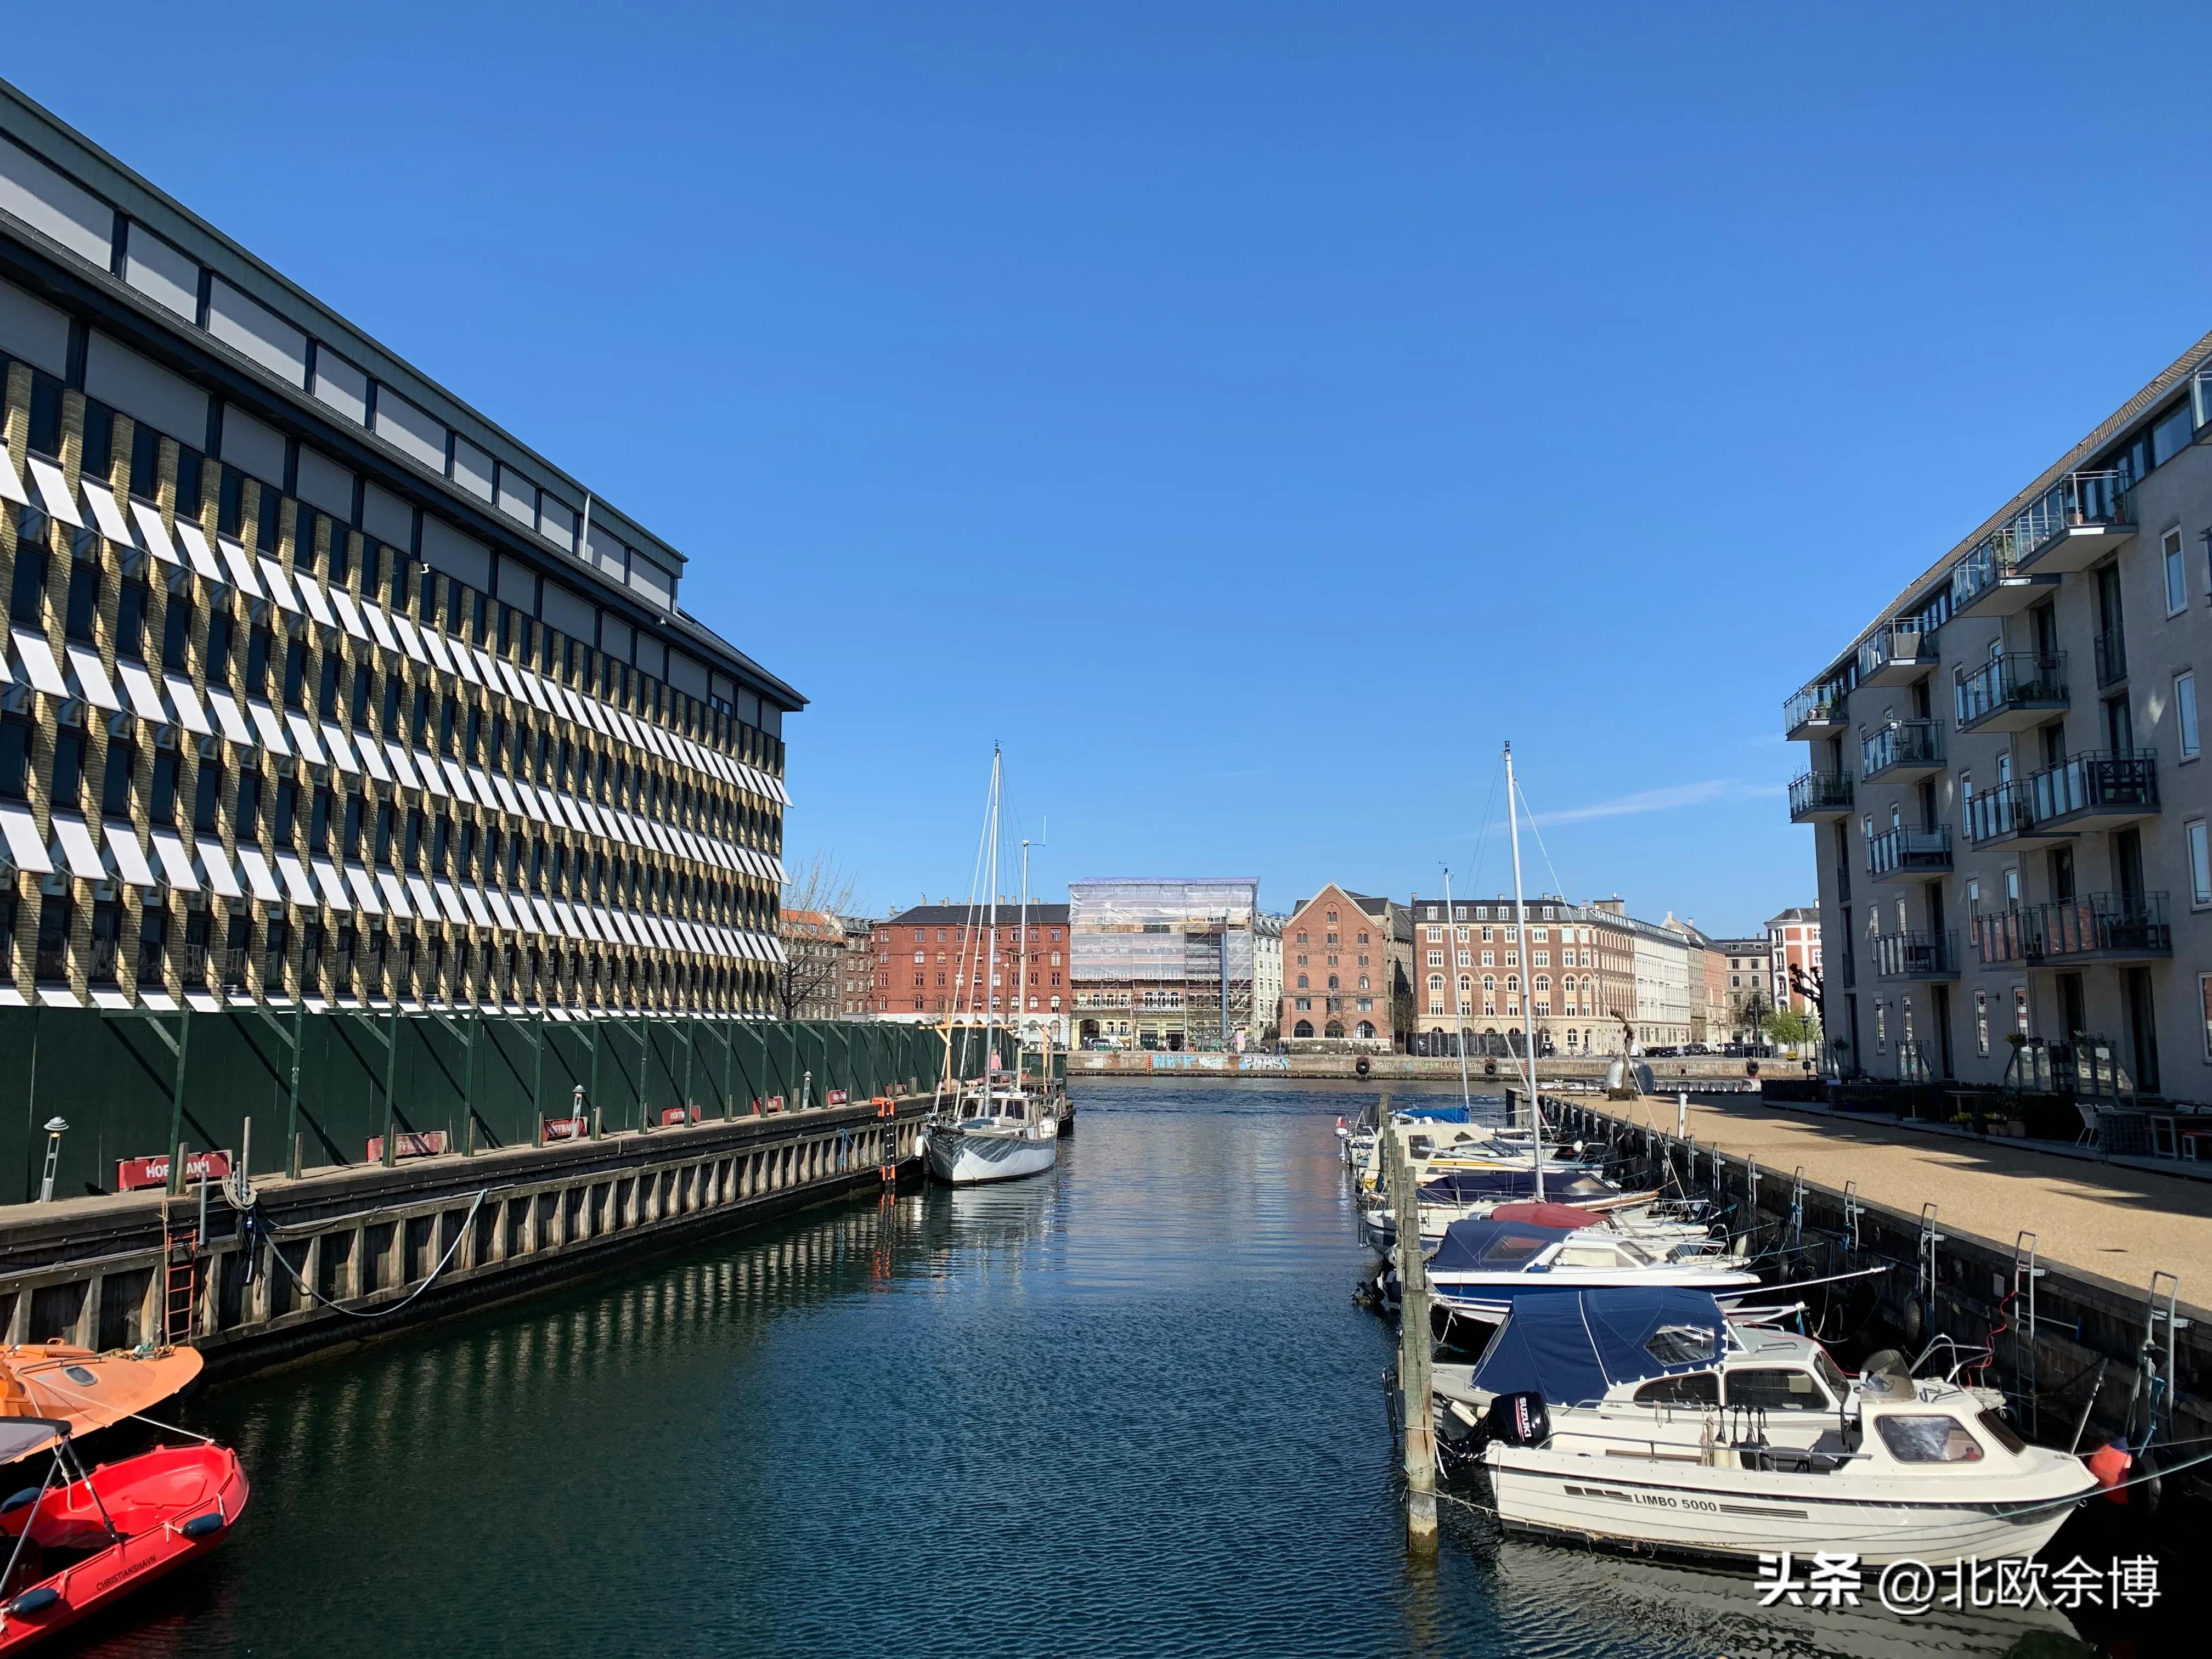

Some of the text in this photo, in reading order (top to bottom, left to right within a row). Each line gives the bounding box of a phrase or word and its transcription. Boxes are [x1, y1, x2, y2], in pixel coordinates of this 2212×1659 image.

[146, 1160, 210, 1178] HOFANN
[1519, 1397, 1532, 1437] SUZUKI
[1634, 1494, 1717, 1511] LIMBO 5000
[96, 1555, 156, 1591] CHRISTIANSHAVN
